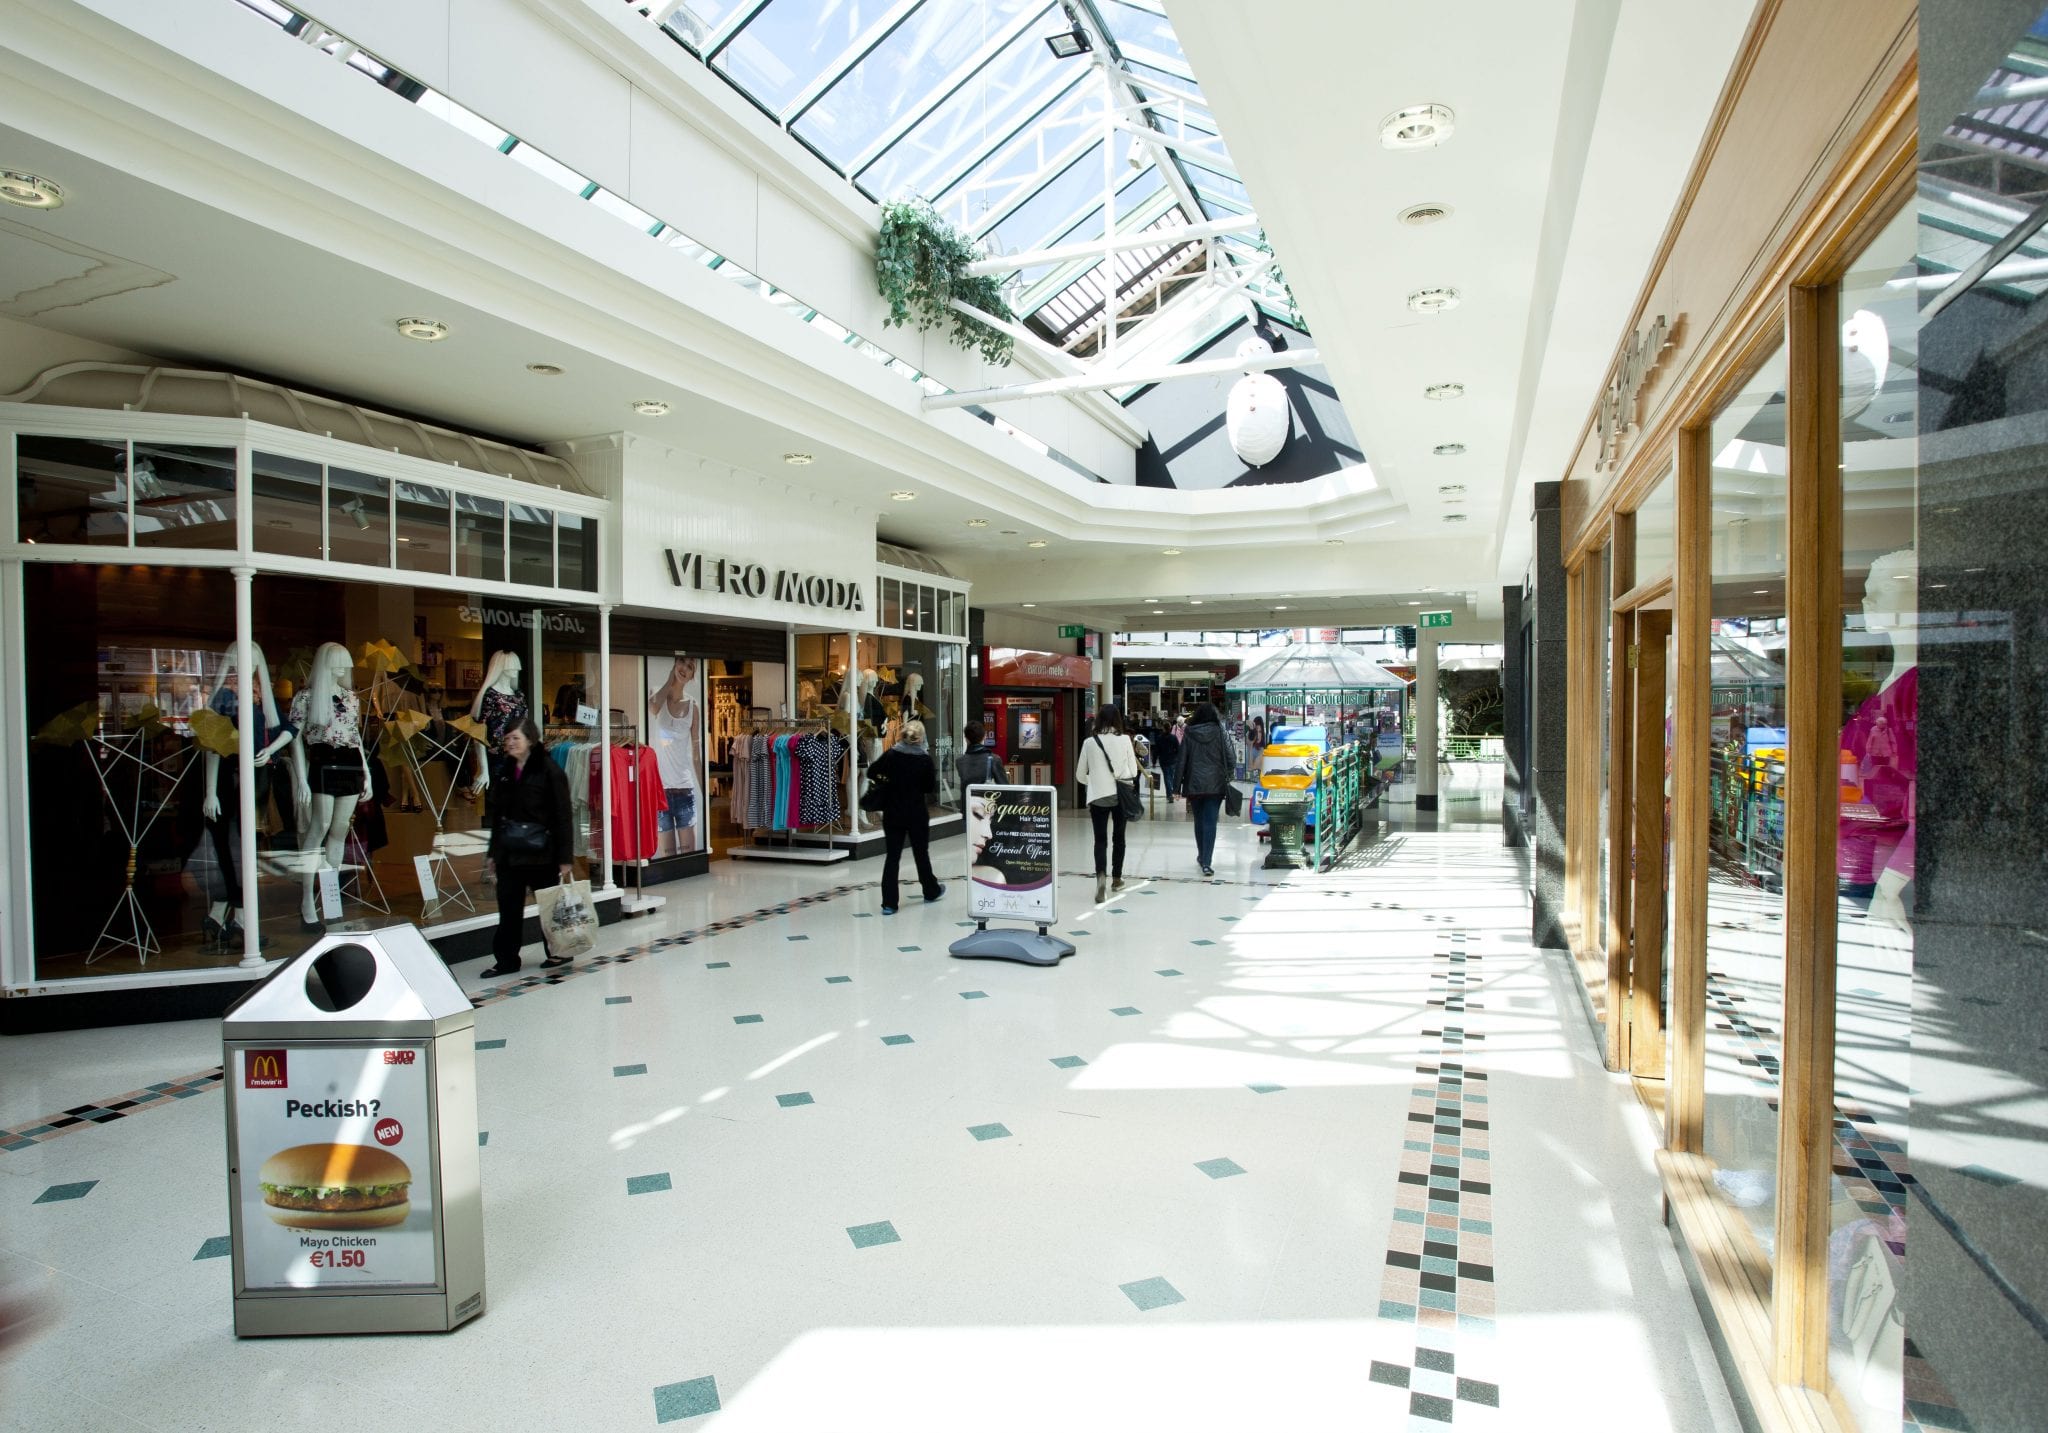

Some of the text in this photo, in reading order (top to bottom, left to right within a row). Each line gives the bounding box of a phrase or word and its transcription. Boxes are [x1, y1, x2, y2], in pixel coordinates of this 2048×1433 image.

[665, 548, 865, 611] VERO MODA
[1048, 664, 1070, 677] meter
[984, 791, 1050, 823] Equave
[989, 842, 1050, 859] Special Offers
[978, 898, 996, 910] ghd
[383, 1050, 416, 1061] euro
[383, 1057, 414, 1065] saver
[286, 1099, 381, 1118] Peckish?
[376, 1124, 400, 1141] NEW
[299, 1236, 377, 1248] Mayo Chicken
[309, 1250, 366, 1268] €1.50
